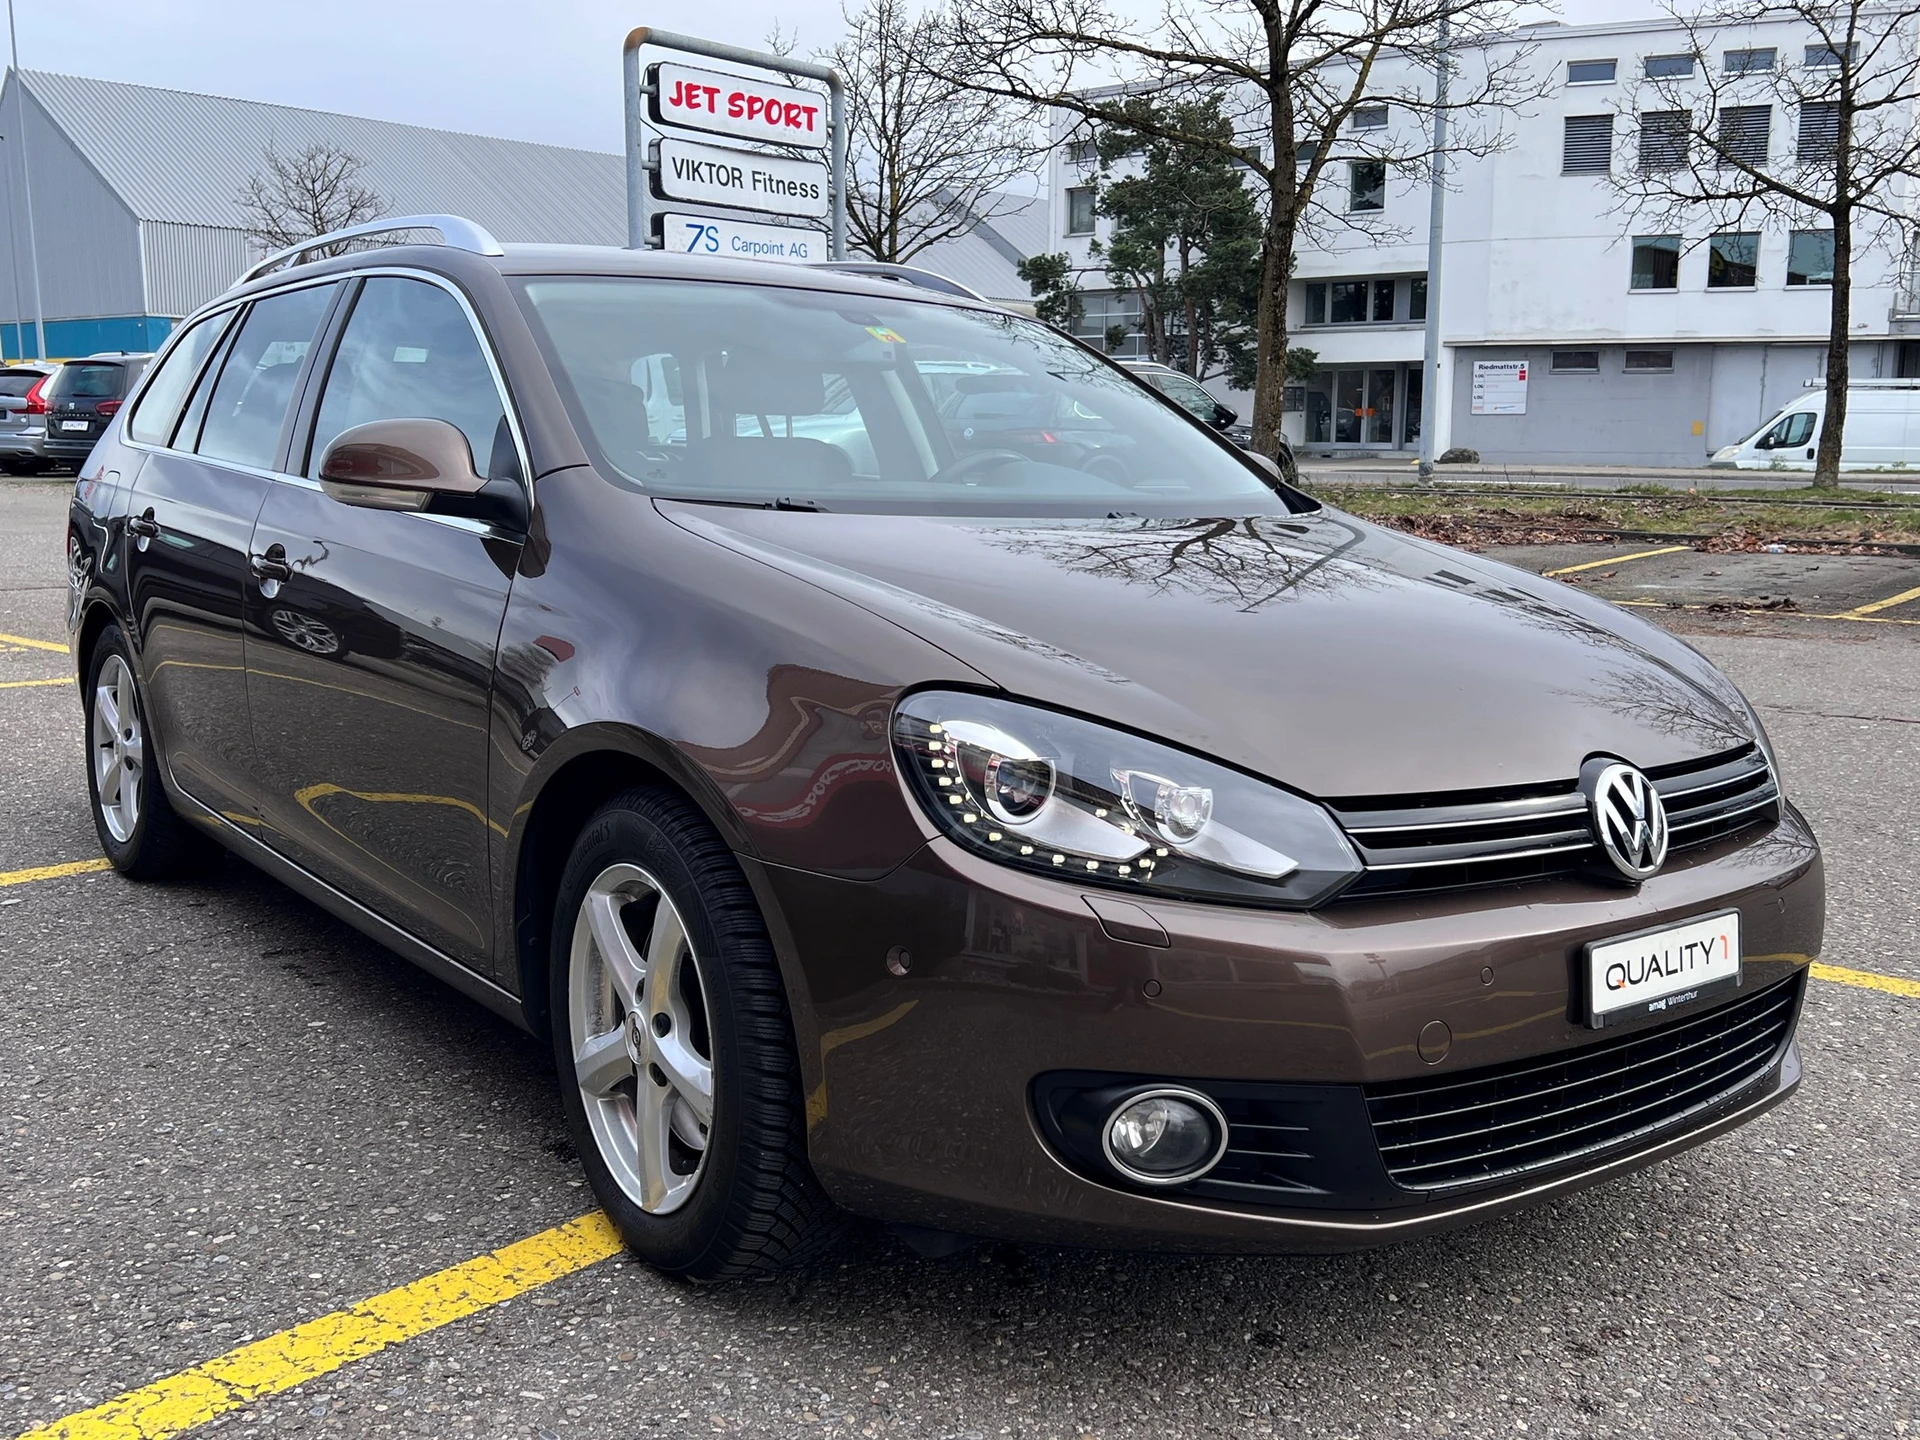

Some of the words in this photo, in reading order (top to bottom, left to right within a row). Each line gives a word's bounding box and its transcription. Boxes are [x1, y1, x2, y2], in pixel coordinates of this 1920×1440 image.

[669, 81, 720, 114] JET
[728, 92, 818, 132] SPORT
[672, 156, 744, 189] VIKTOR
[751, 170, 819, 200] Fitness
[685, 223, 720, 253] 7S
[731, 236, 784, 257] Carpoint
[789, 243, 808, 259] AG
[1648, 999, 1666, 1011] amag
[1667, 990, 1698, 1006] Winterthur
